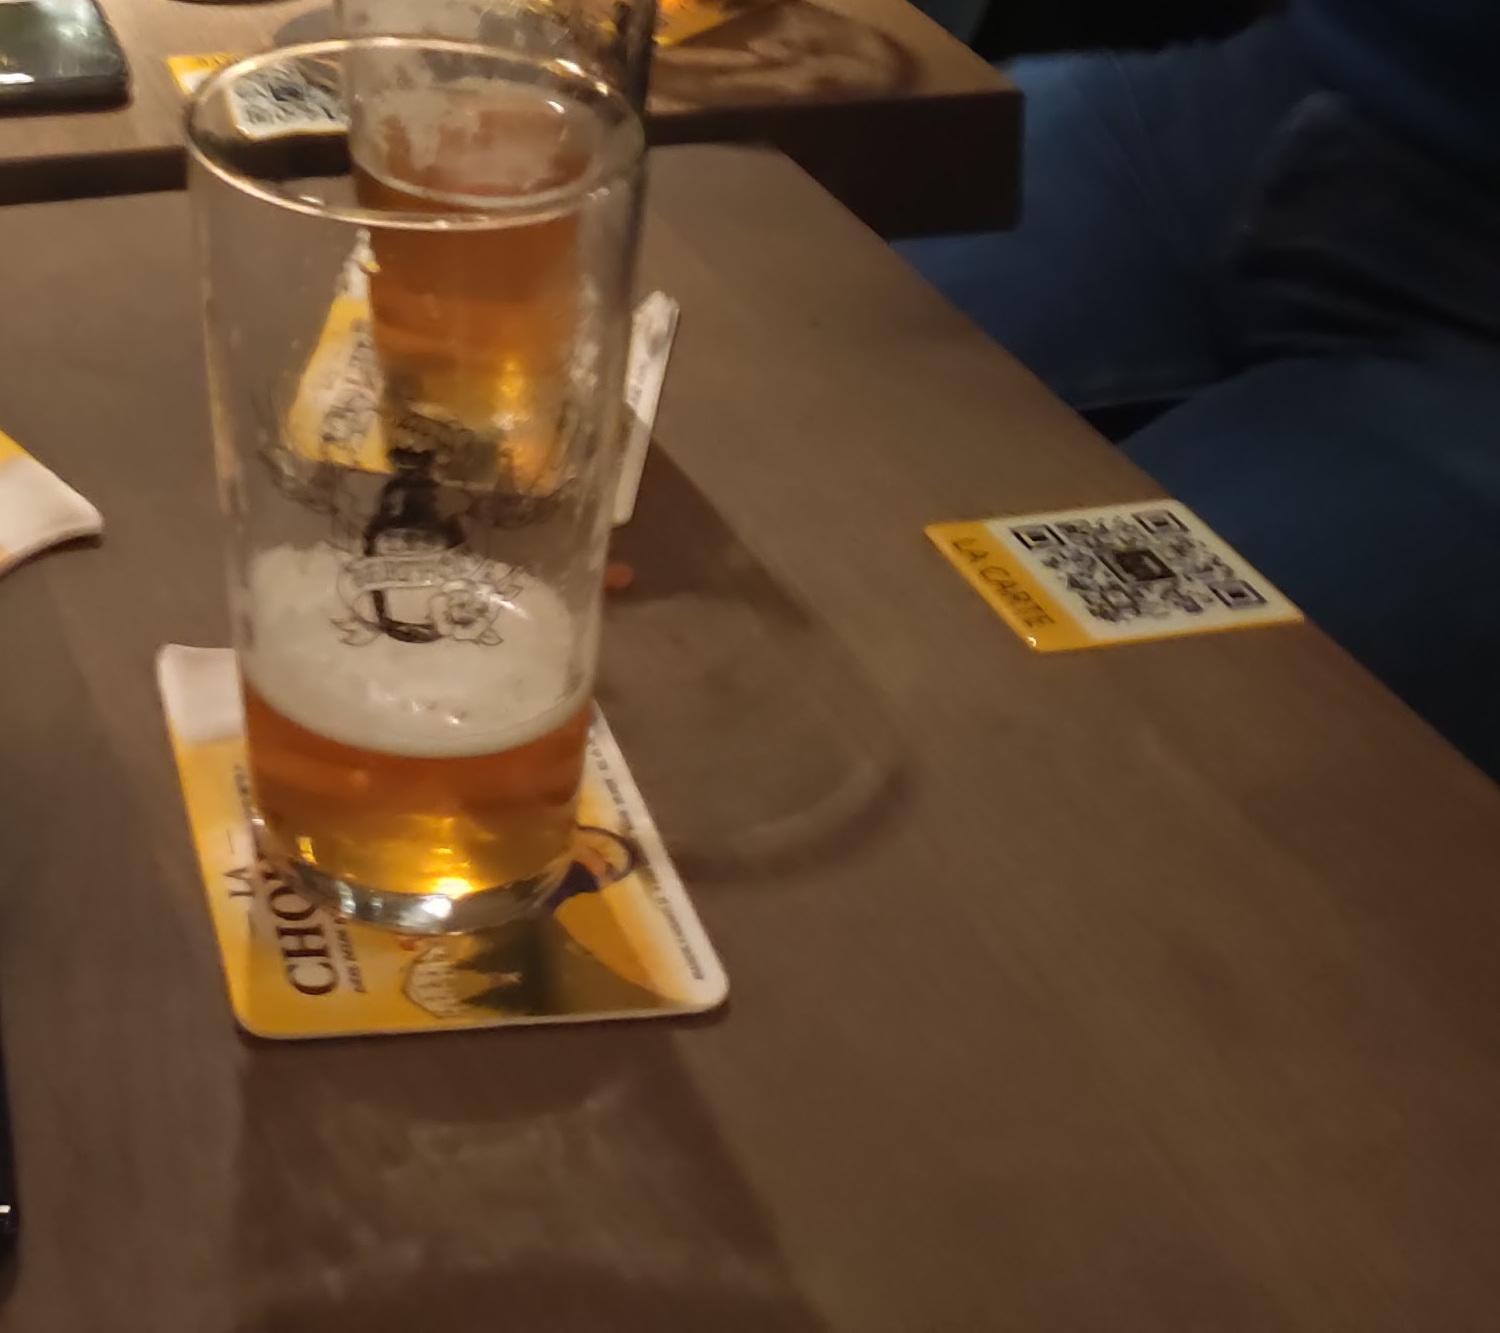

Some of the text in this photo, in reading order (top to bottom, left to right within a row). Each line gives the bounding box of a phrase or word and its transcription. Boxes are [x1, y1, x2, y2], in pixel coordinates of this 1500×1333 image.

[951, 536, 1056, 630] LA CARTE
[223, 865, 257, 901] LA
